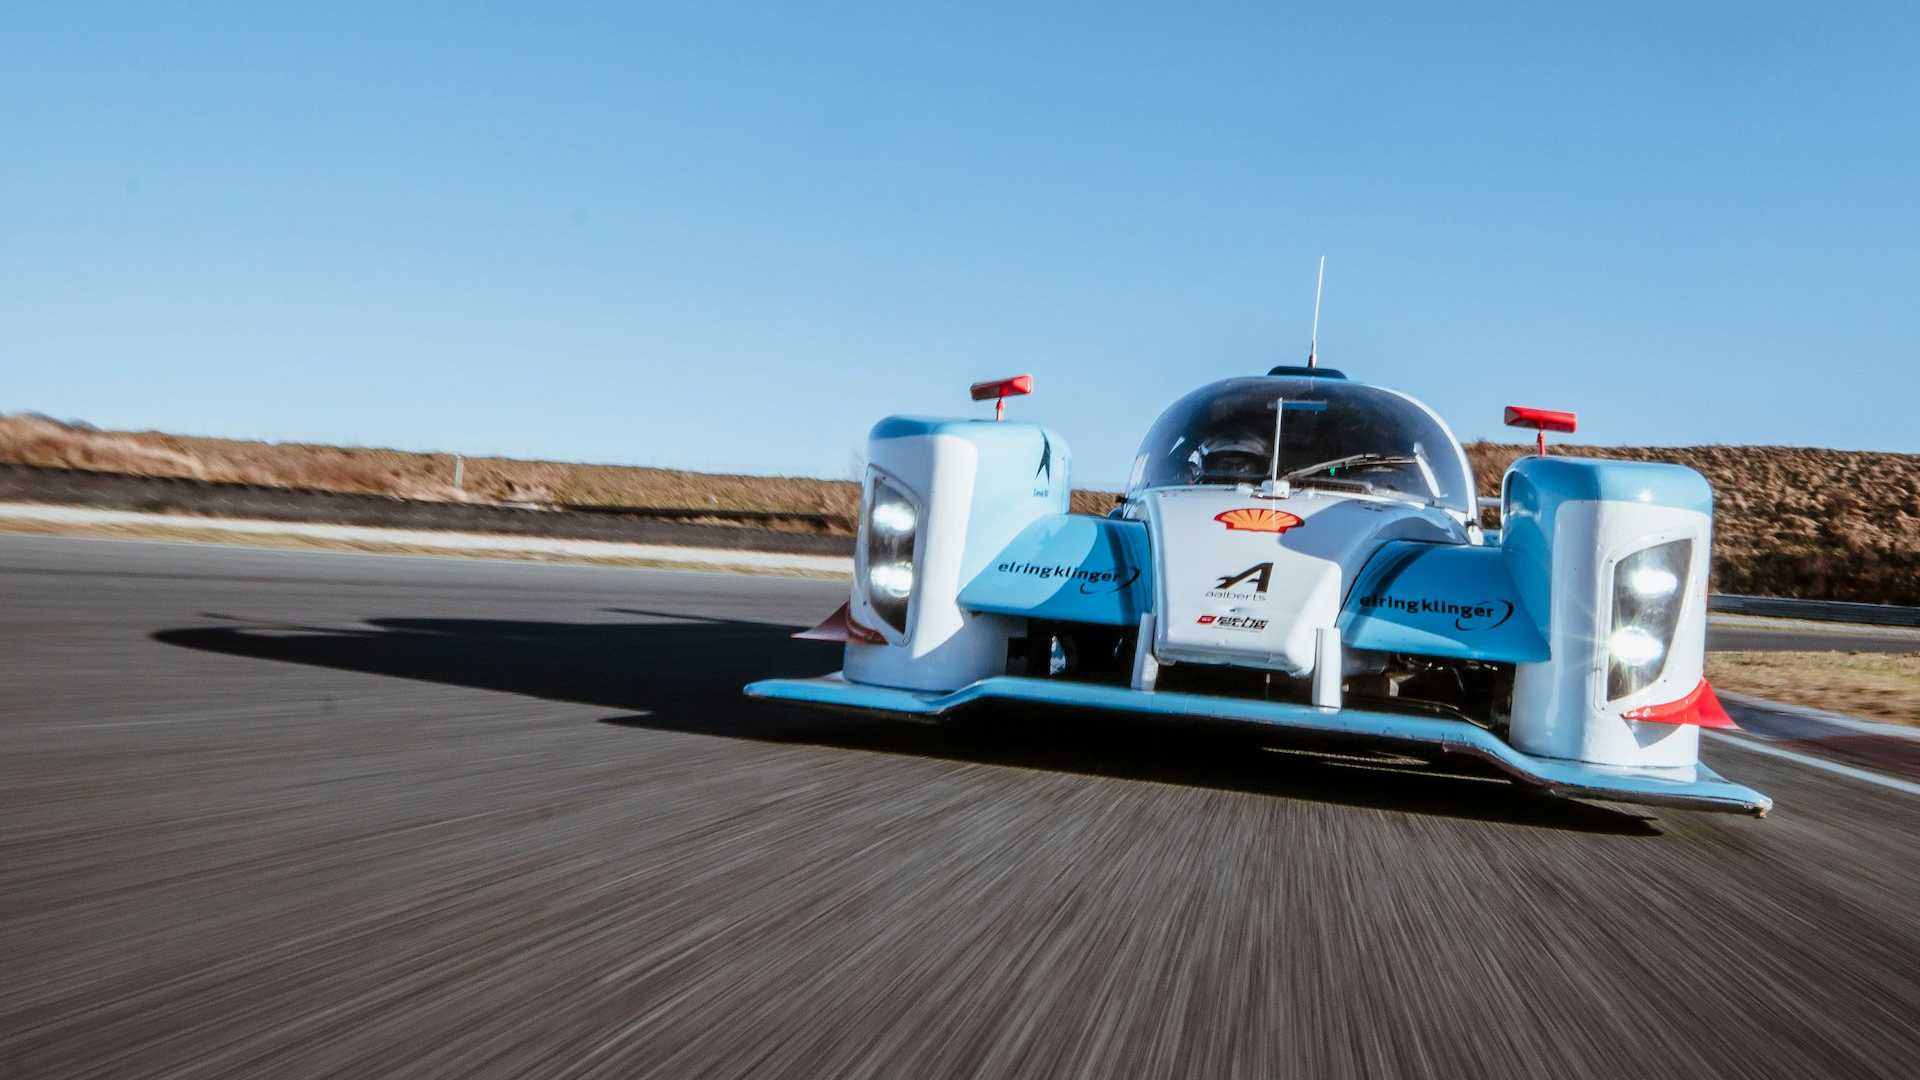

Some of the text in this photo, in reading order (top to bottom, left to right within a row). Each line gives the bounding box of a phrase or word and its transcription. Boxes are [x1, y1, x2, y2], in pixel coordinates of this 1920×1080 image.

[998, 561, 1121, 582] elringklinger
[1205, 591, 1266, 600] aalberts
[1360, 595, 1494, 618] elringklinger
